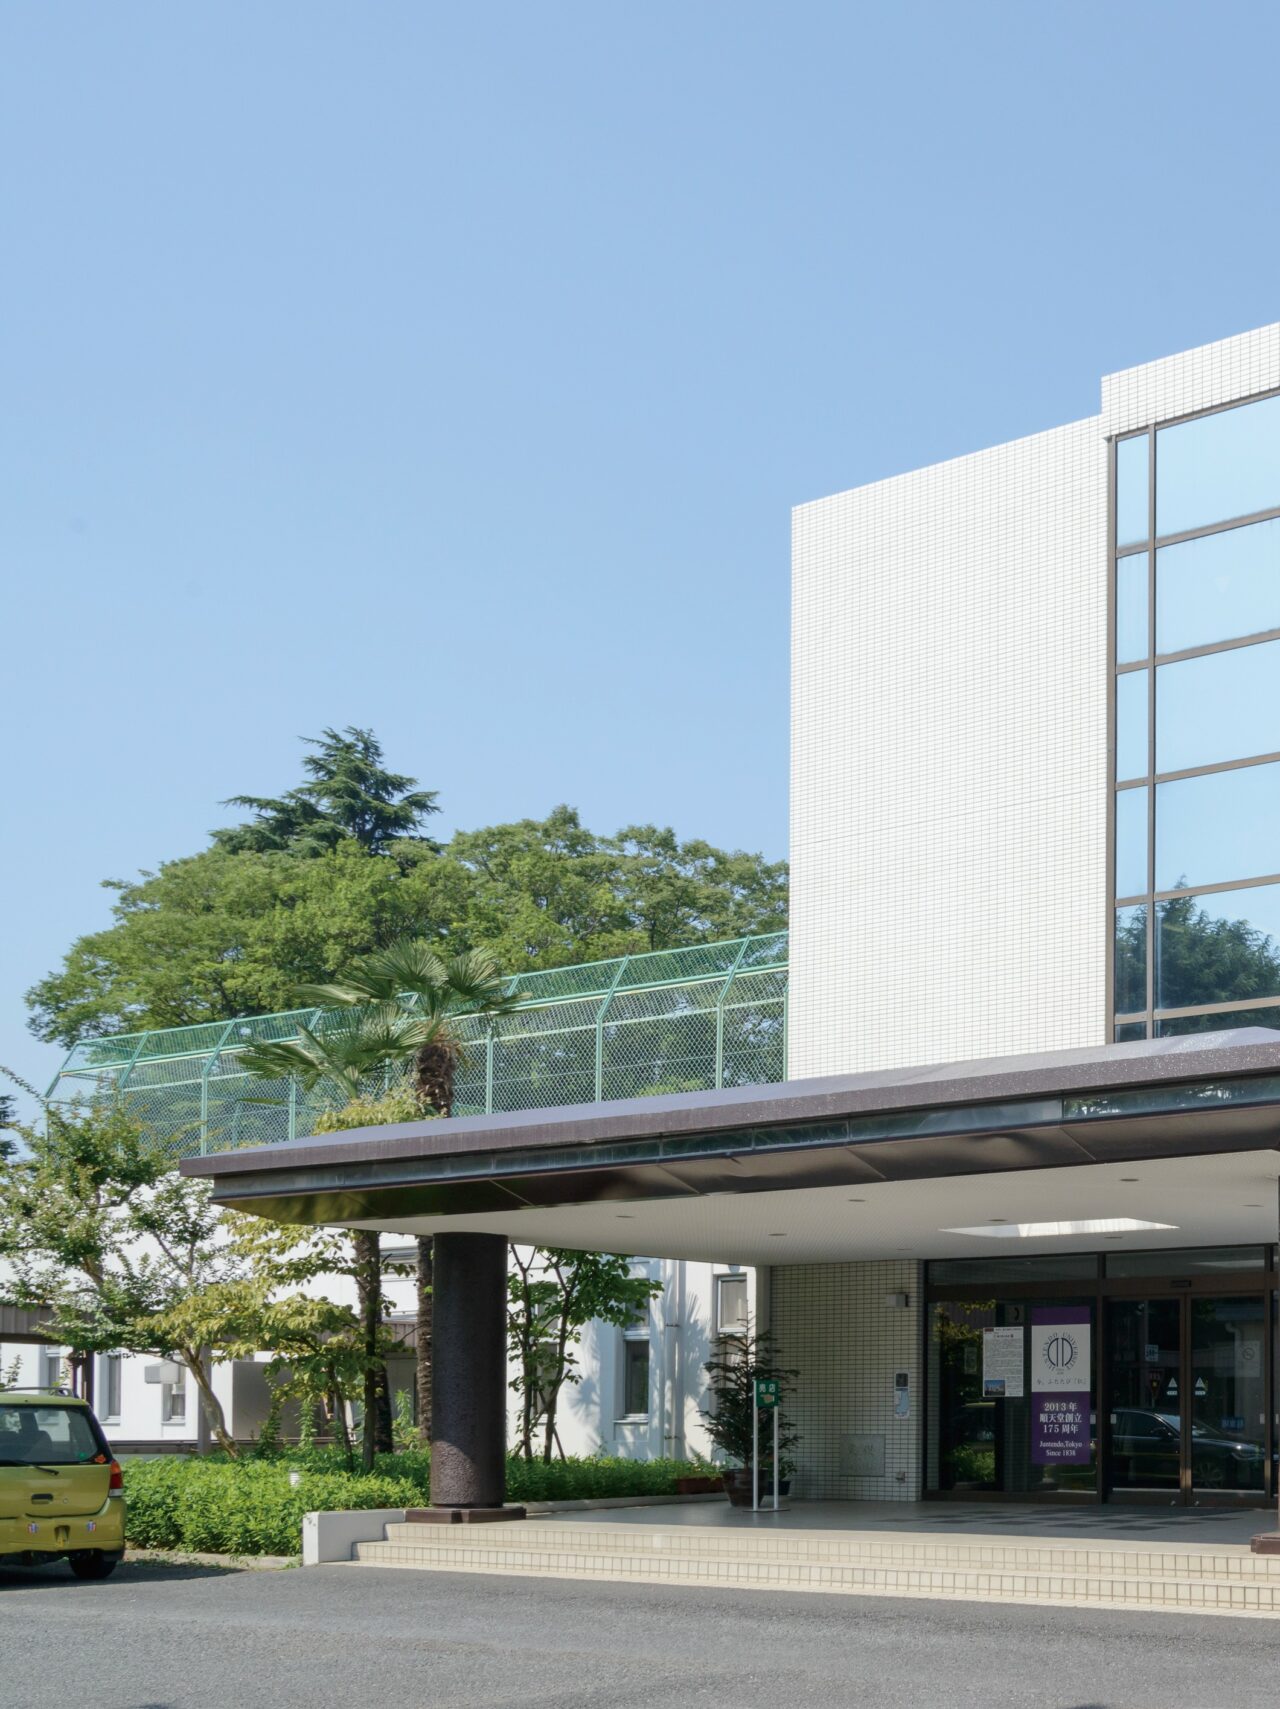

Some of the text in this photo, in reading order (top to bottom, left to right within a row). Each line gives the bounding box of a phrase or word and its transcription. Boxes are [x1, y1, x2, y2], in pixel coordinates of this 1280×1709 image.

[1039, 1412, 1082, 1423] 順天堂創立
